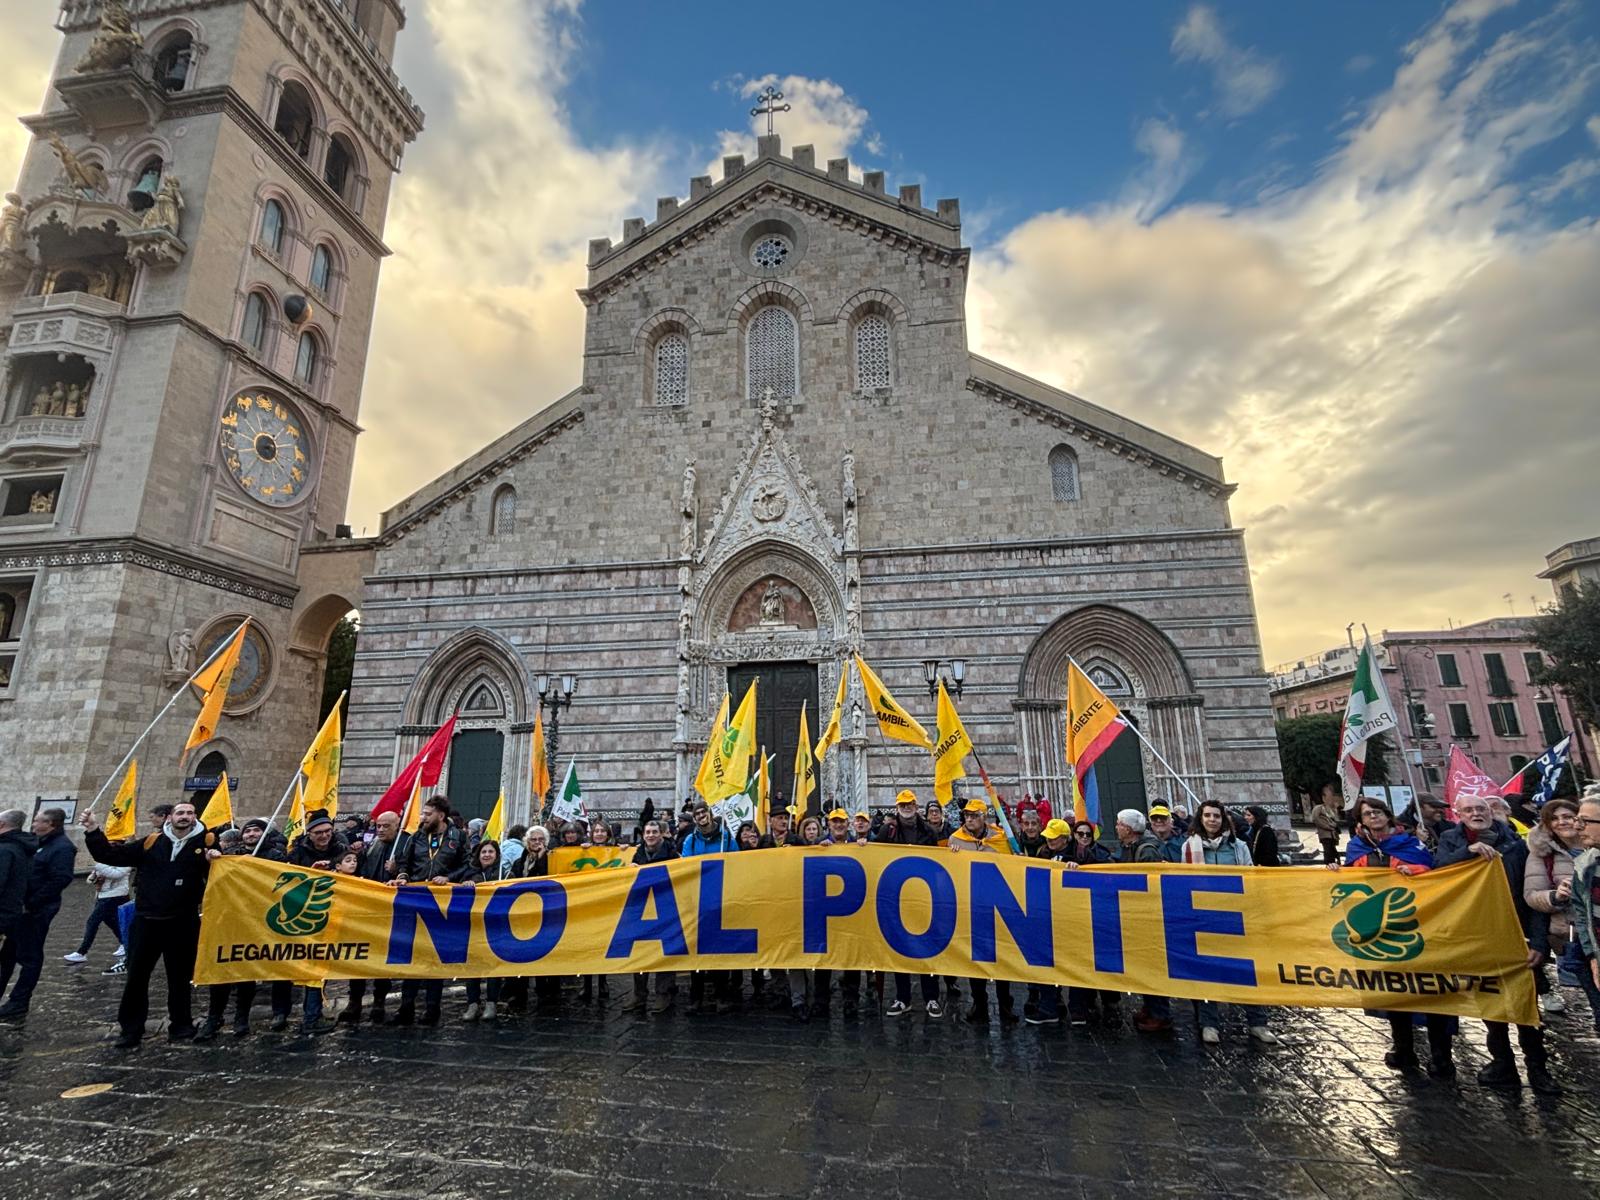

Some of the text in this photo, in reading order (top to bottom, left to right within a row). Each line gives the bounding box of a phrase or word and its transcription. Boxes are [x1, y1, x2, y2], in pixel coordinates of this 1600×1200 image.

[876, 711, 910, 728] AMBIE
[386, 856, 1257, 987] NO AL PONTE
[216, 942, 370, 964] LEGAMBIENTE
[1277, 963, 1502, 996] LEGAMBIENTE
